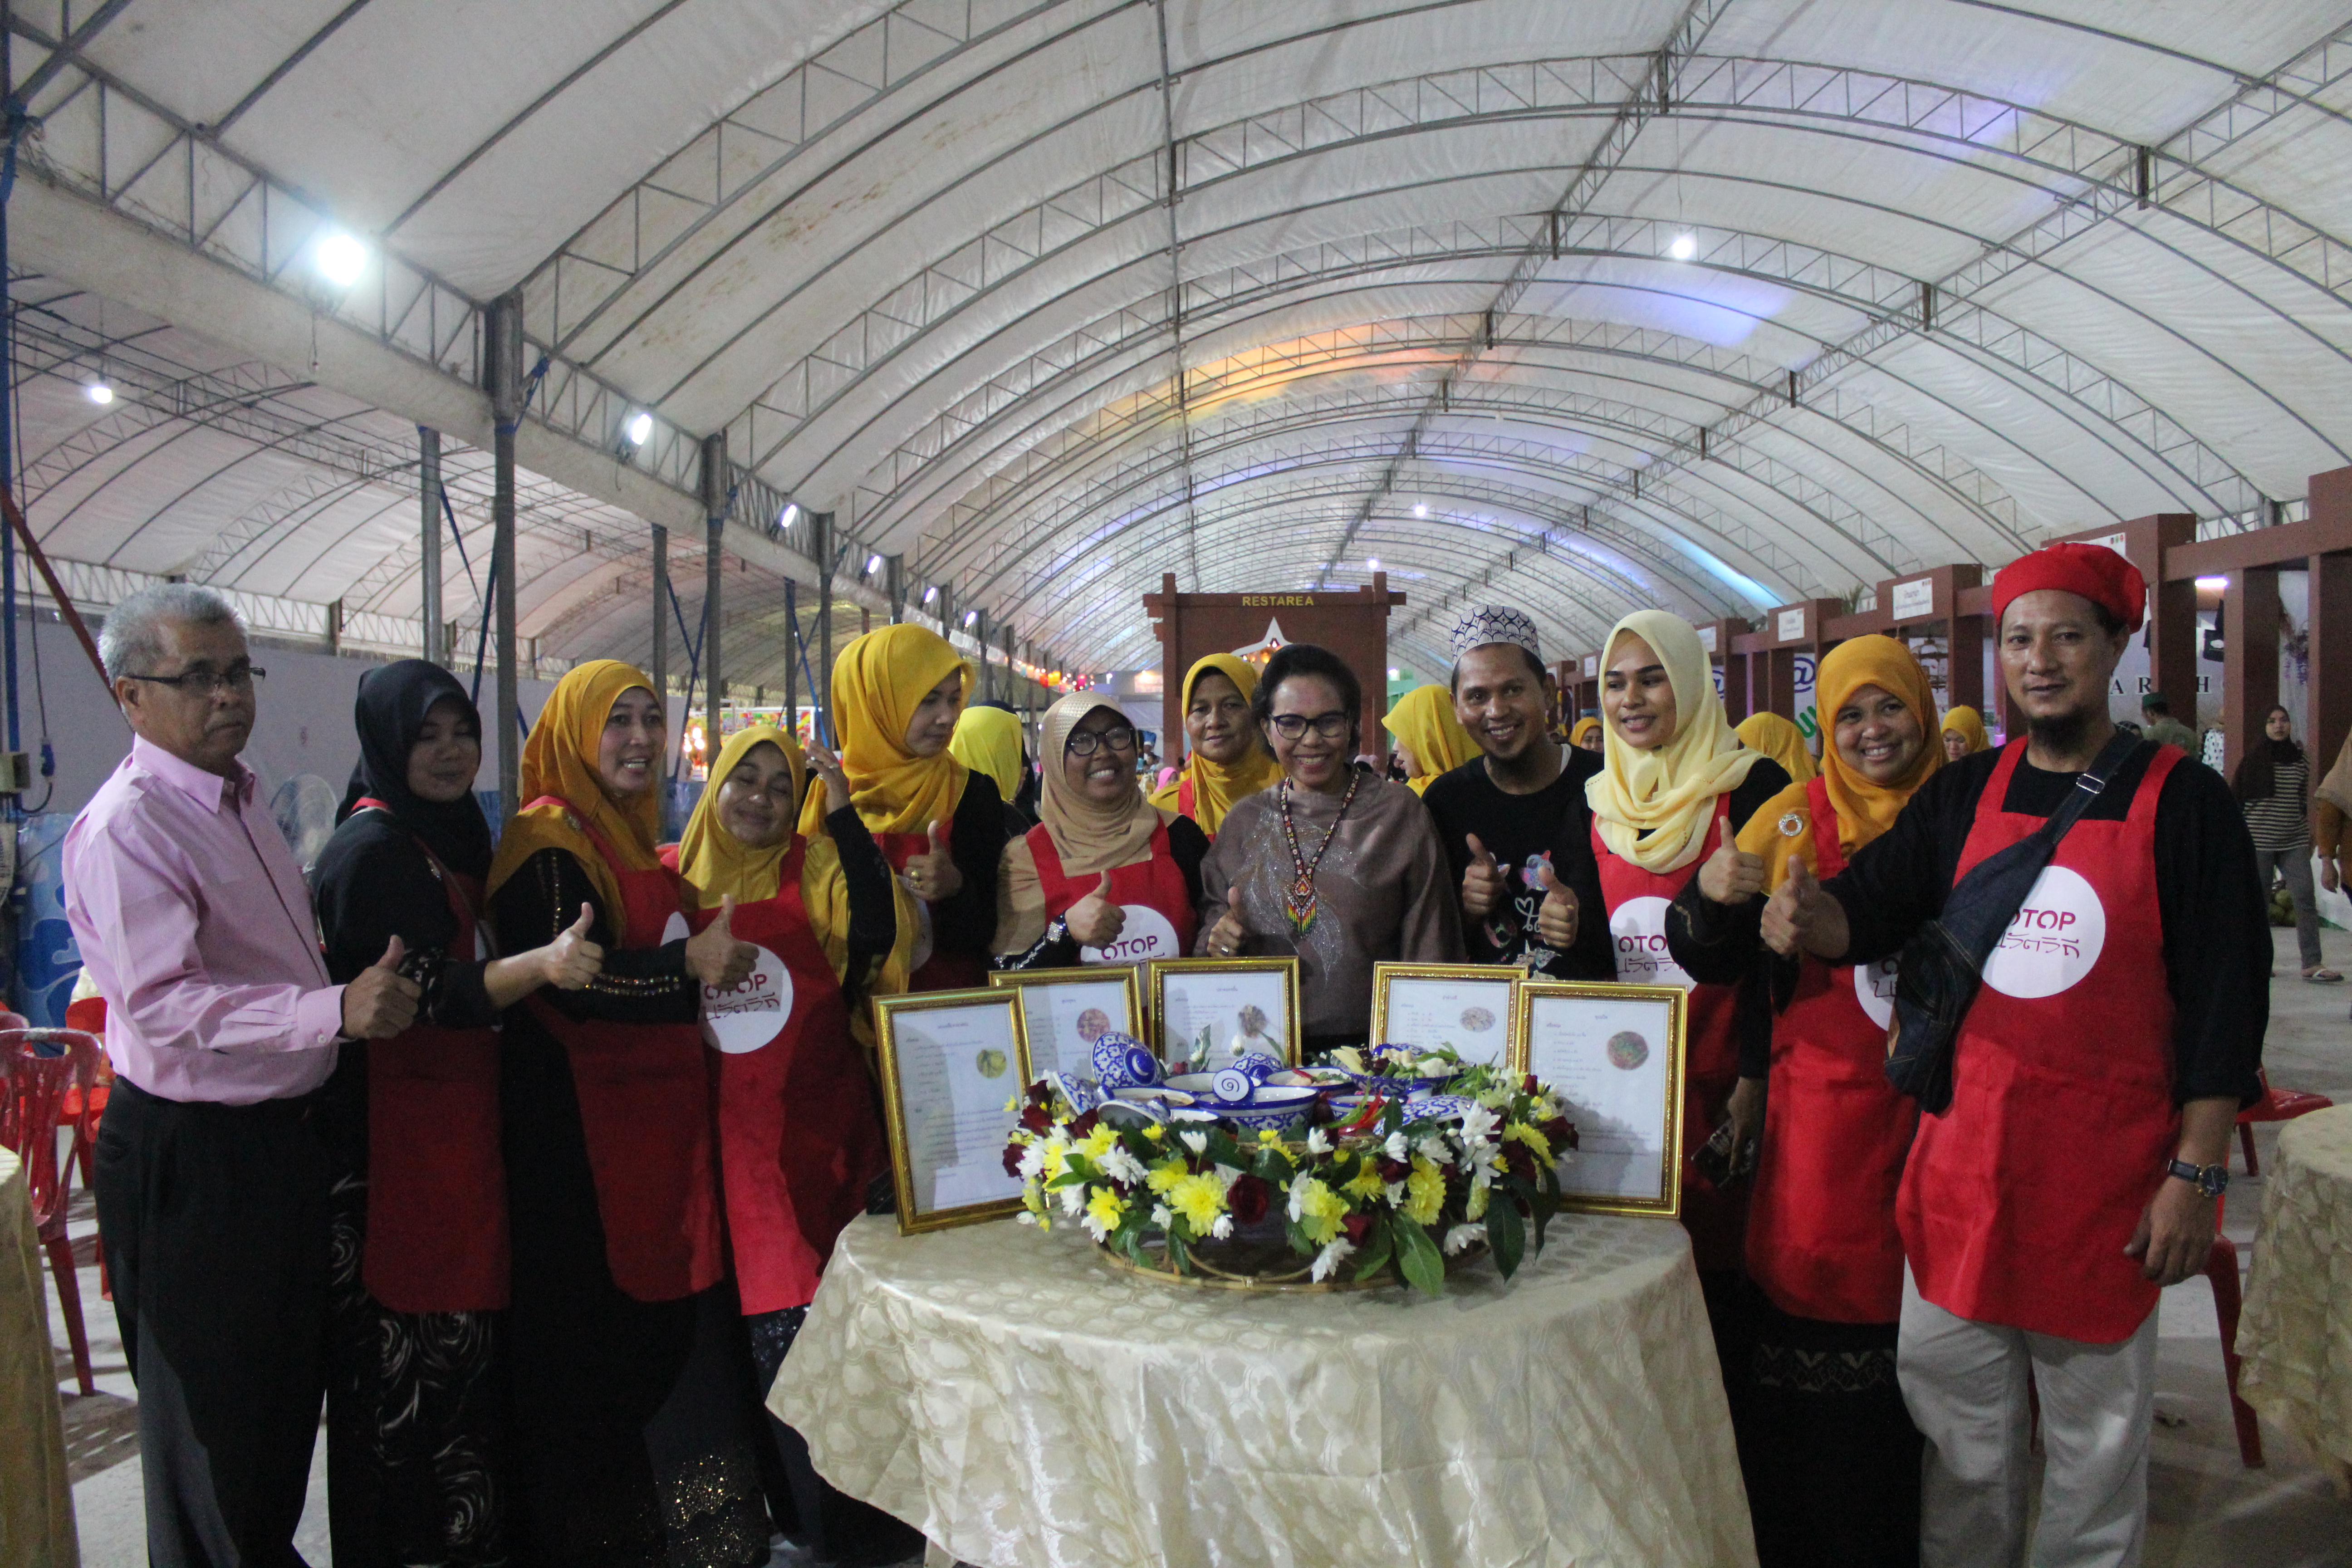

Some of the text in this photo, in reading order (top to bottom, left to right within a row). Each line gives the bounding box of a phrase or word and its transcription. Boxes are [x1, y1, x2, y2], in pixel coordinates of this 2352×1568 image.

[1101, 936, 1158, 960] OTOP
[1618, 935, 1667, 952] OTO
[705, 974, 767, 1000] OOP
